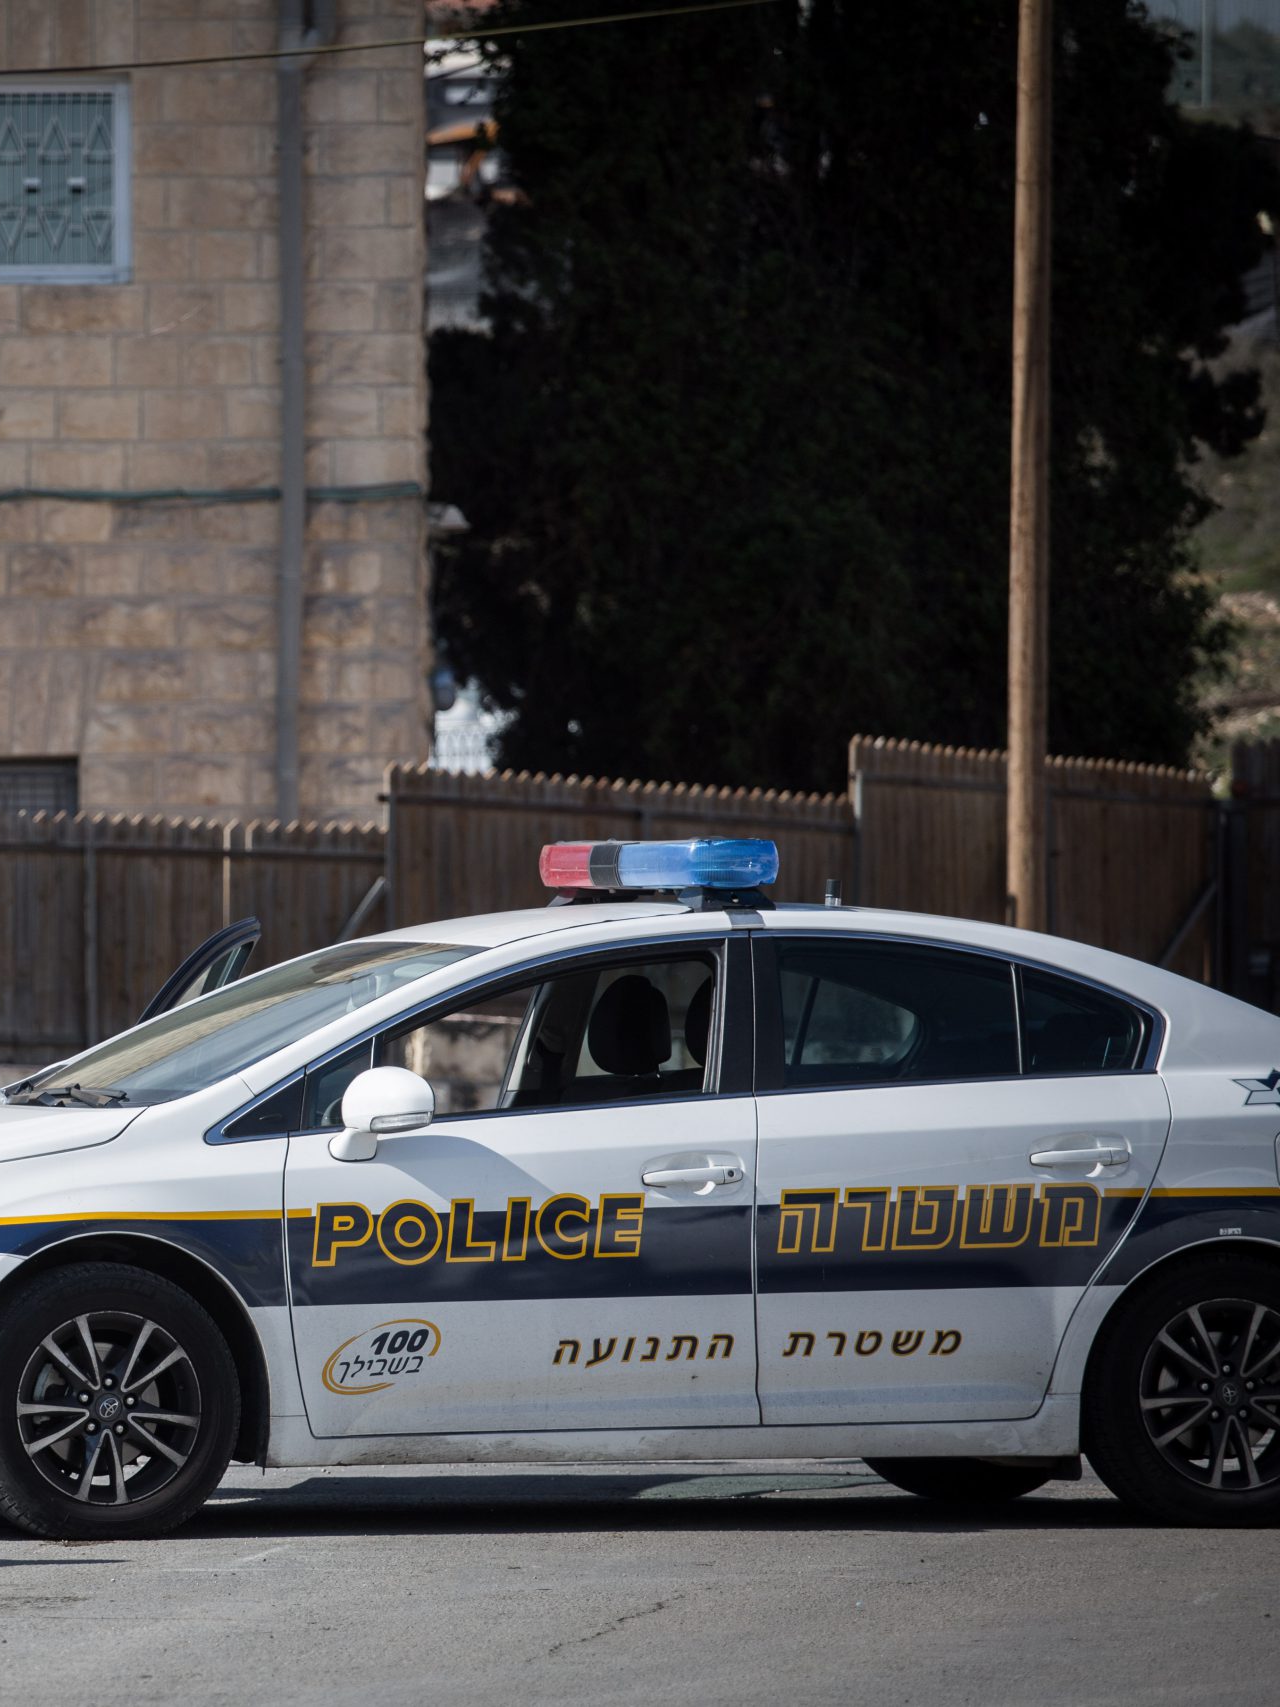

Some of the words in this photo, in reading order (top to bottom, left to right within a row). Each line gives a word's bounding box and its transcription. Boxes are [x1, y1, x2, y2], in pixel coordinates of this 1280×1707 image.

[311, 1192, 645, 1267] POLICE
[777, 1182, 1102, 1253] משטרה
[371, 1328, 430, 1356] 100
[551, 1333, 735, 1368] התנועה
[782, 1328, 963, 1358] משטרת
[339, 1355, 424, 1384] בשבילך
